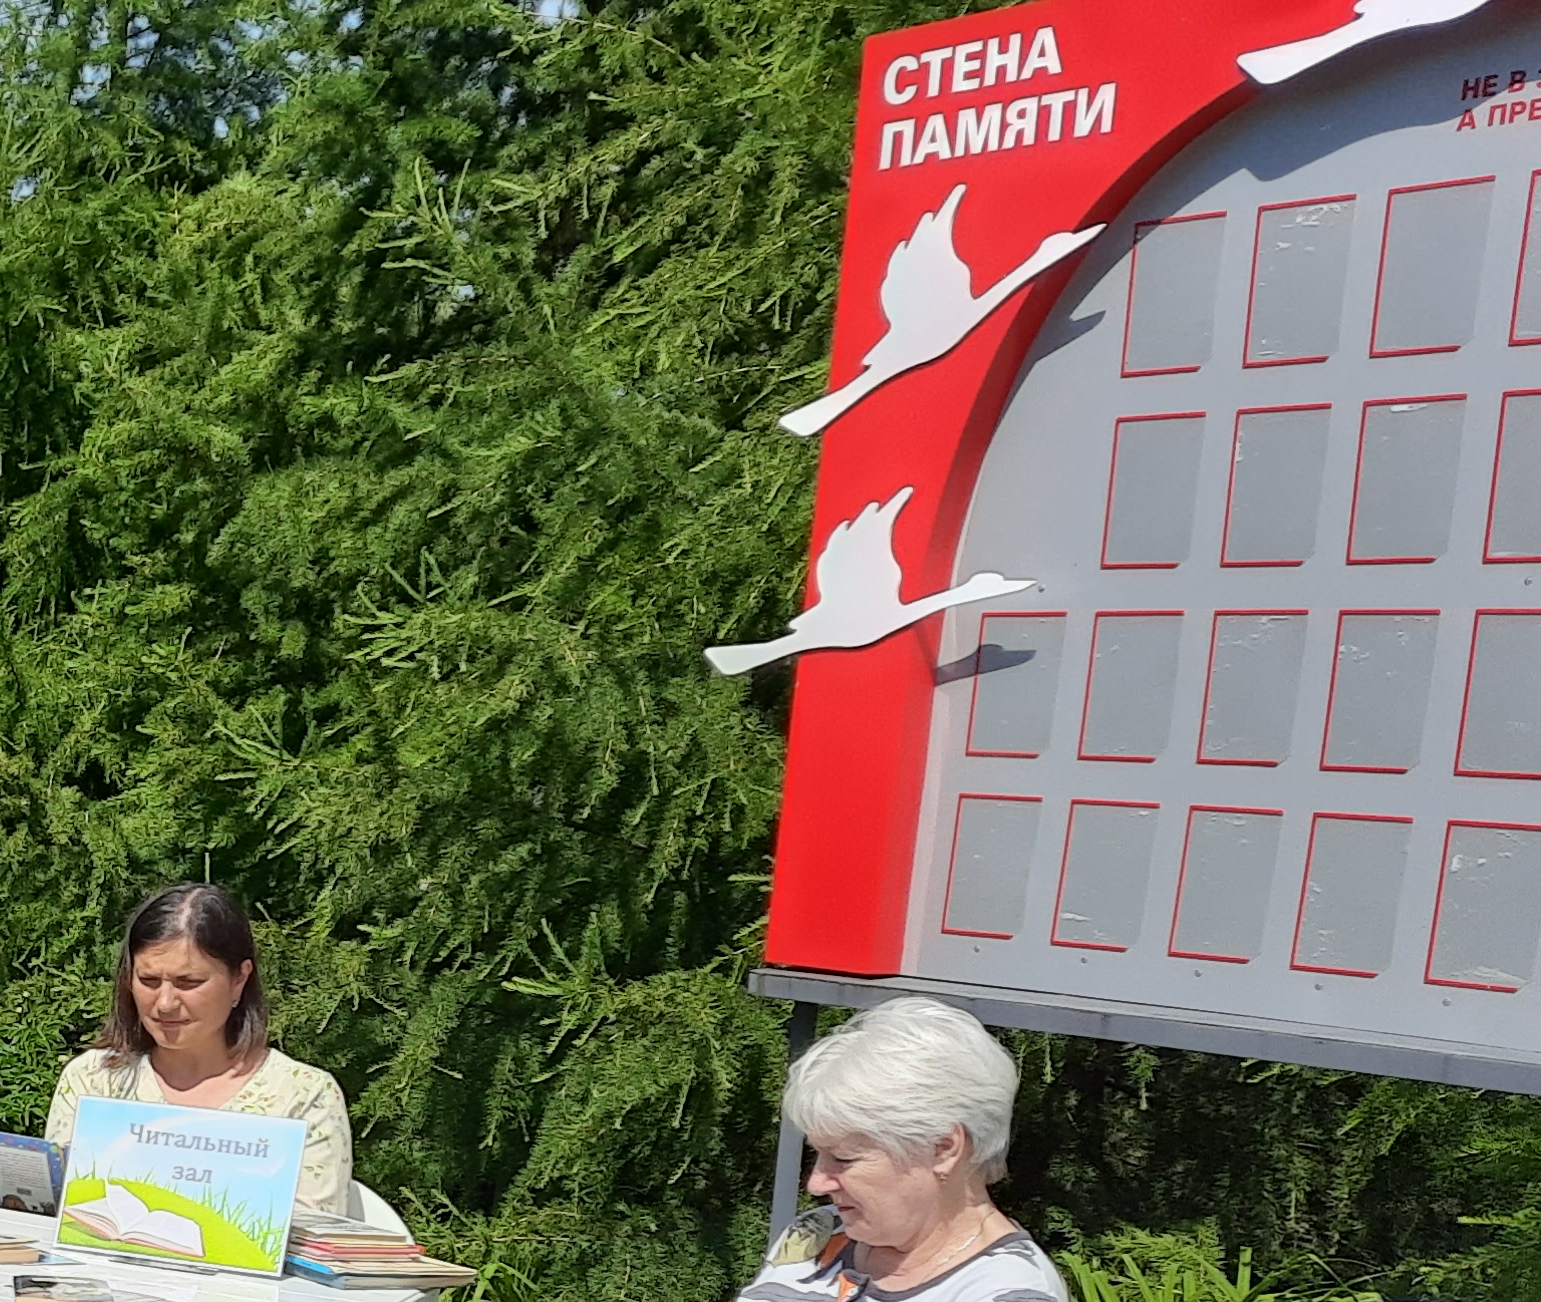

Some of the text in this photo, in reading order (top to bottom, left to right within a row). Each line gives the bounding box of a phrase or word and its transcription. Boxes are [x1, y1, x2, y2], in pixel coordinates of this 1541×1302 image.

[883, 26, 1063, 106] СТЕНА
[1461, 74, 1499, 101] НЕ
[1508, 70, 1527, 93] В
[877, 83, 1117, 170] ПАМЯТИ
[1456, 108, 1476, 131] А
[130, 1123, 271, 1158] Читальный
[172, 1165, 213, 1184] зал
